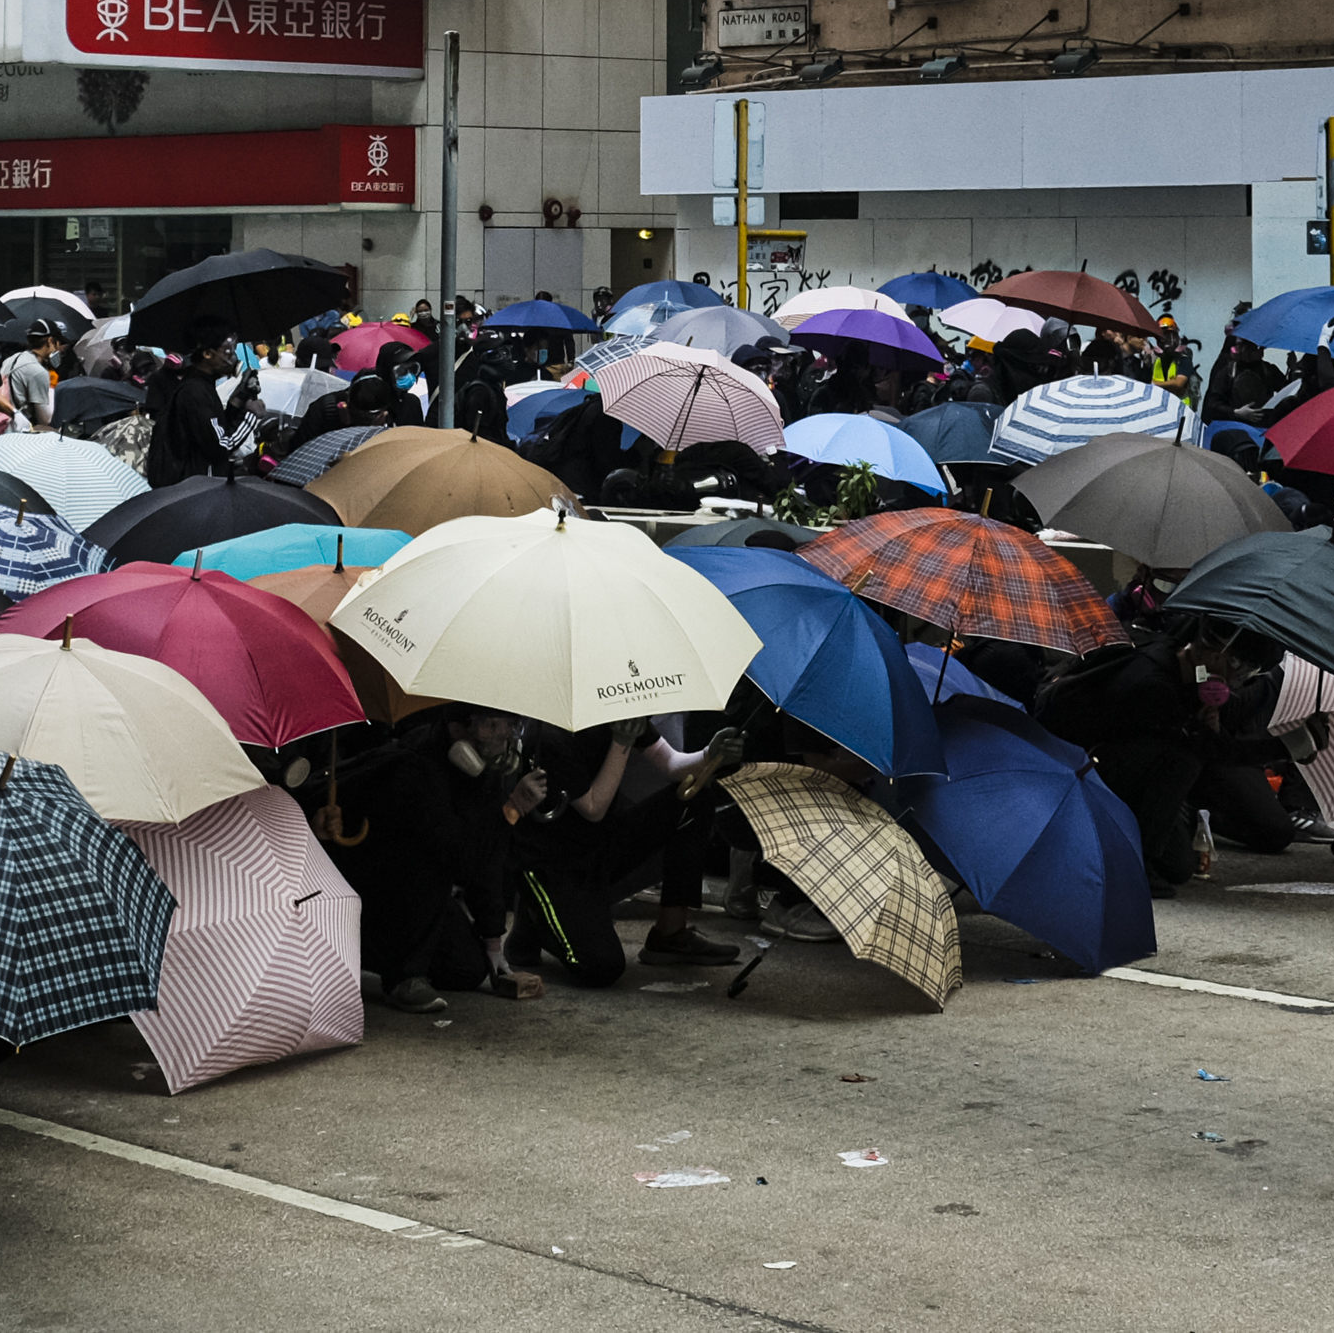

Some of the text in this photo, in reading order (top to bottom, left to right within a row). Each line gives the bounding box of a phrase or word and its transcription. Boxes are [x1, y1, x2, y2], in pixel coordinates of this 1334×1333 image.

[722, 11, 801, 26] NATHAN ROAD
[351, 182, 372, 192] BEA
[362, 606, 416, 654] ROSEMOUNT
[596, 673, 685, 700] ROSEMOUNT
[624, 691, 660, 704] ESTATE
